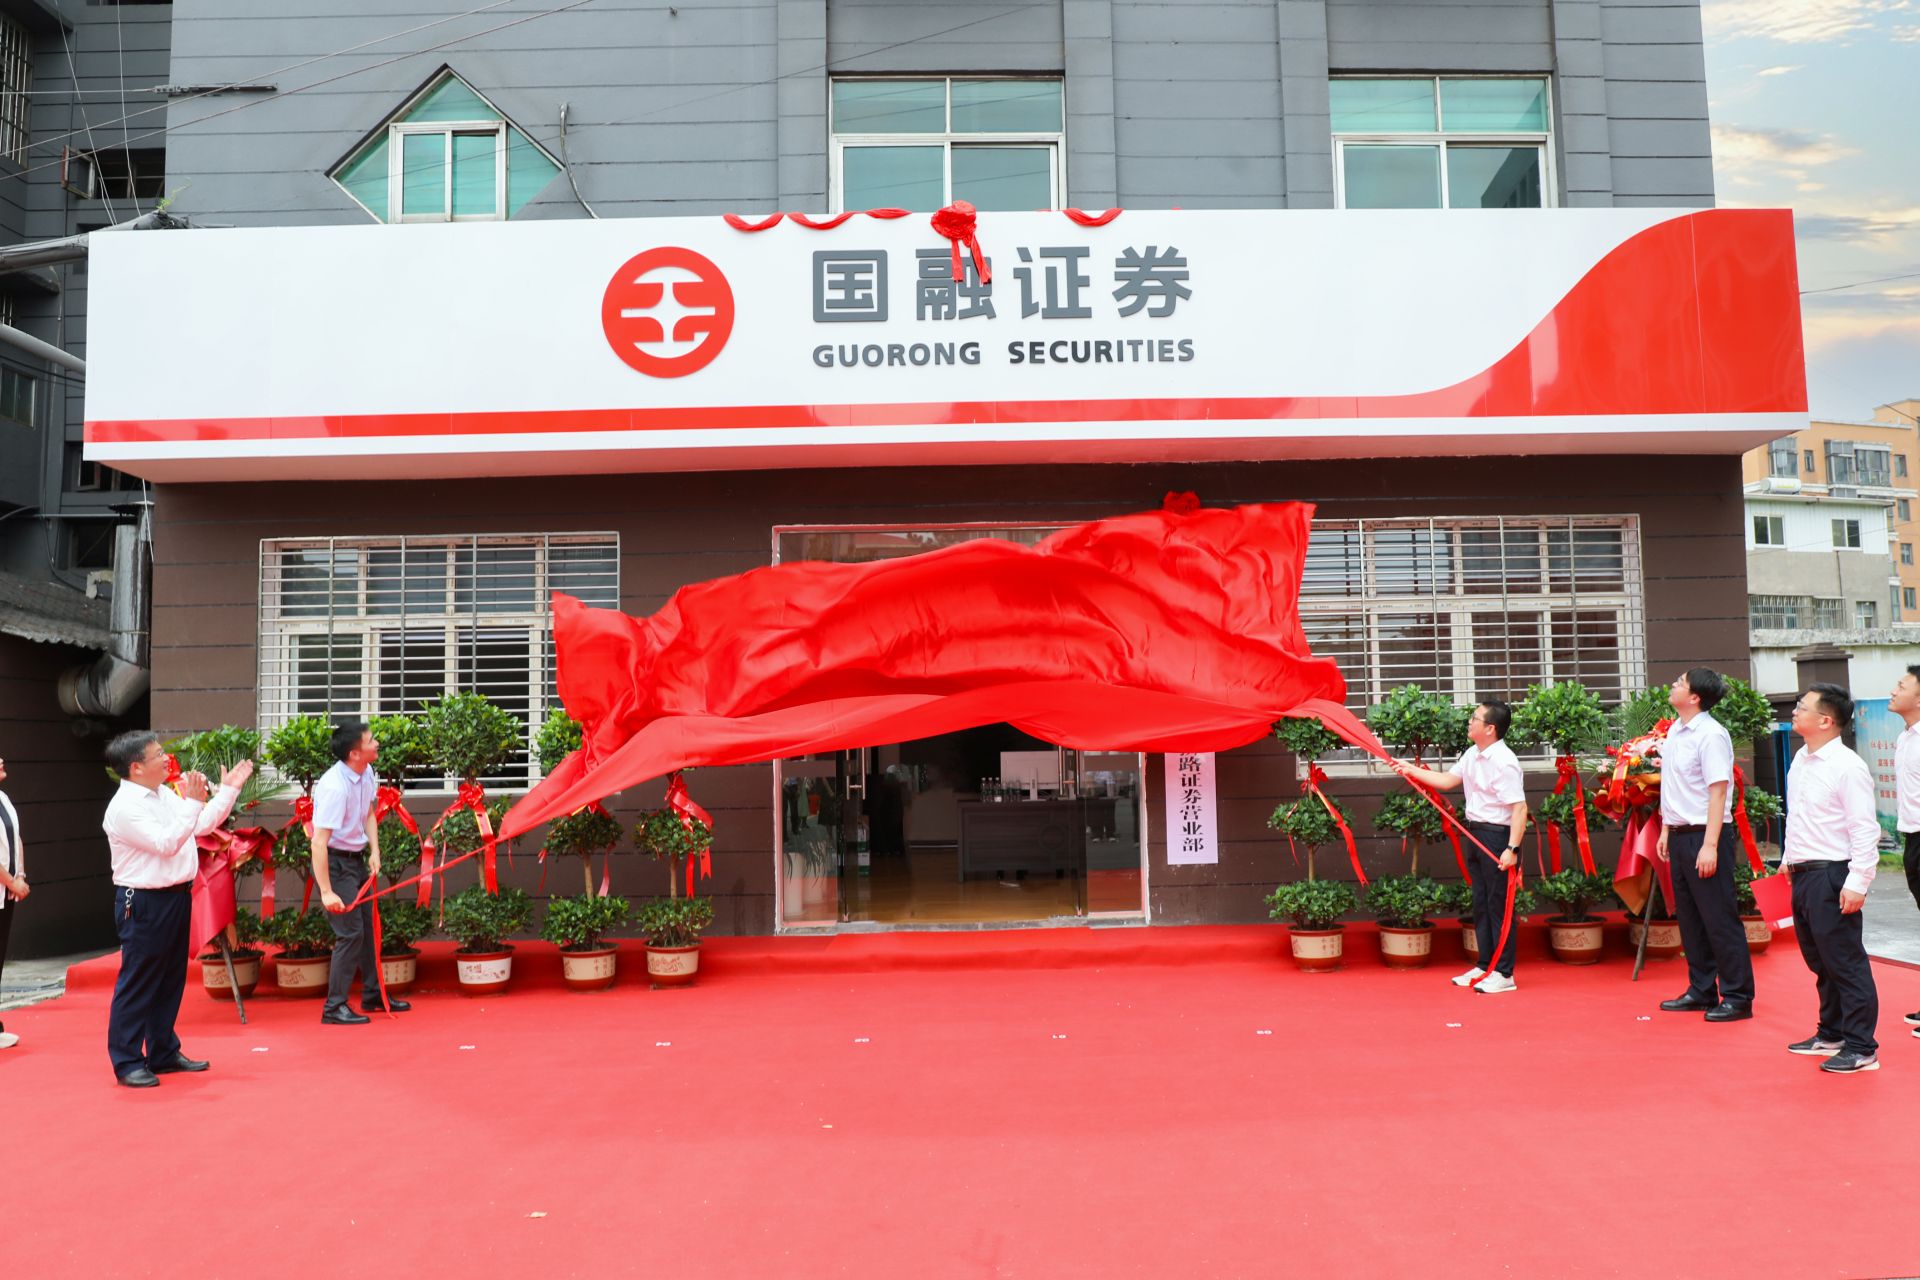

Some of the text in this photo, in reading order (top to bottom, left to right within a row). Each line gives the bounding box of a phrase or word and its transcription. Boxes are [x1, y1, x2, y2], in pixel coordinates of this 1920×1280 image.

[812, 245, 1193, 322] 国融证券
[812, 338, 1195, 368] GUORONG SECURITIES
[1178, 752, 1204, 852] 路证券营业部
